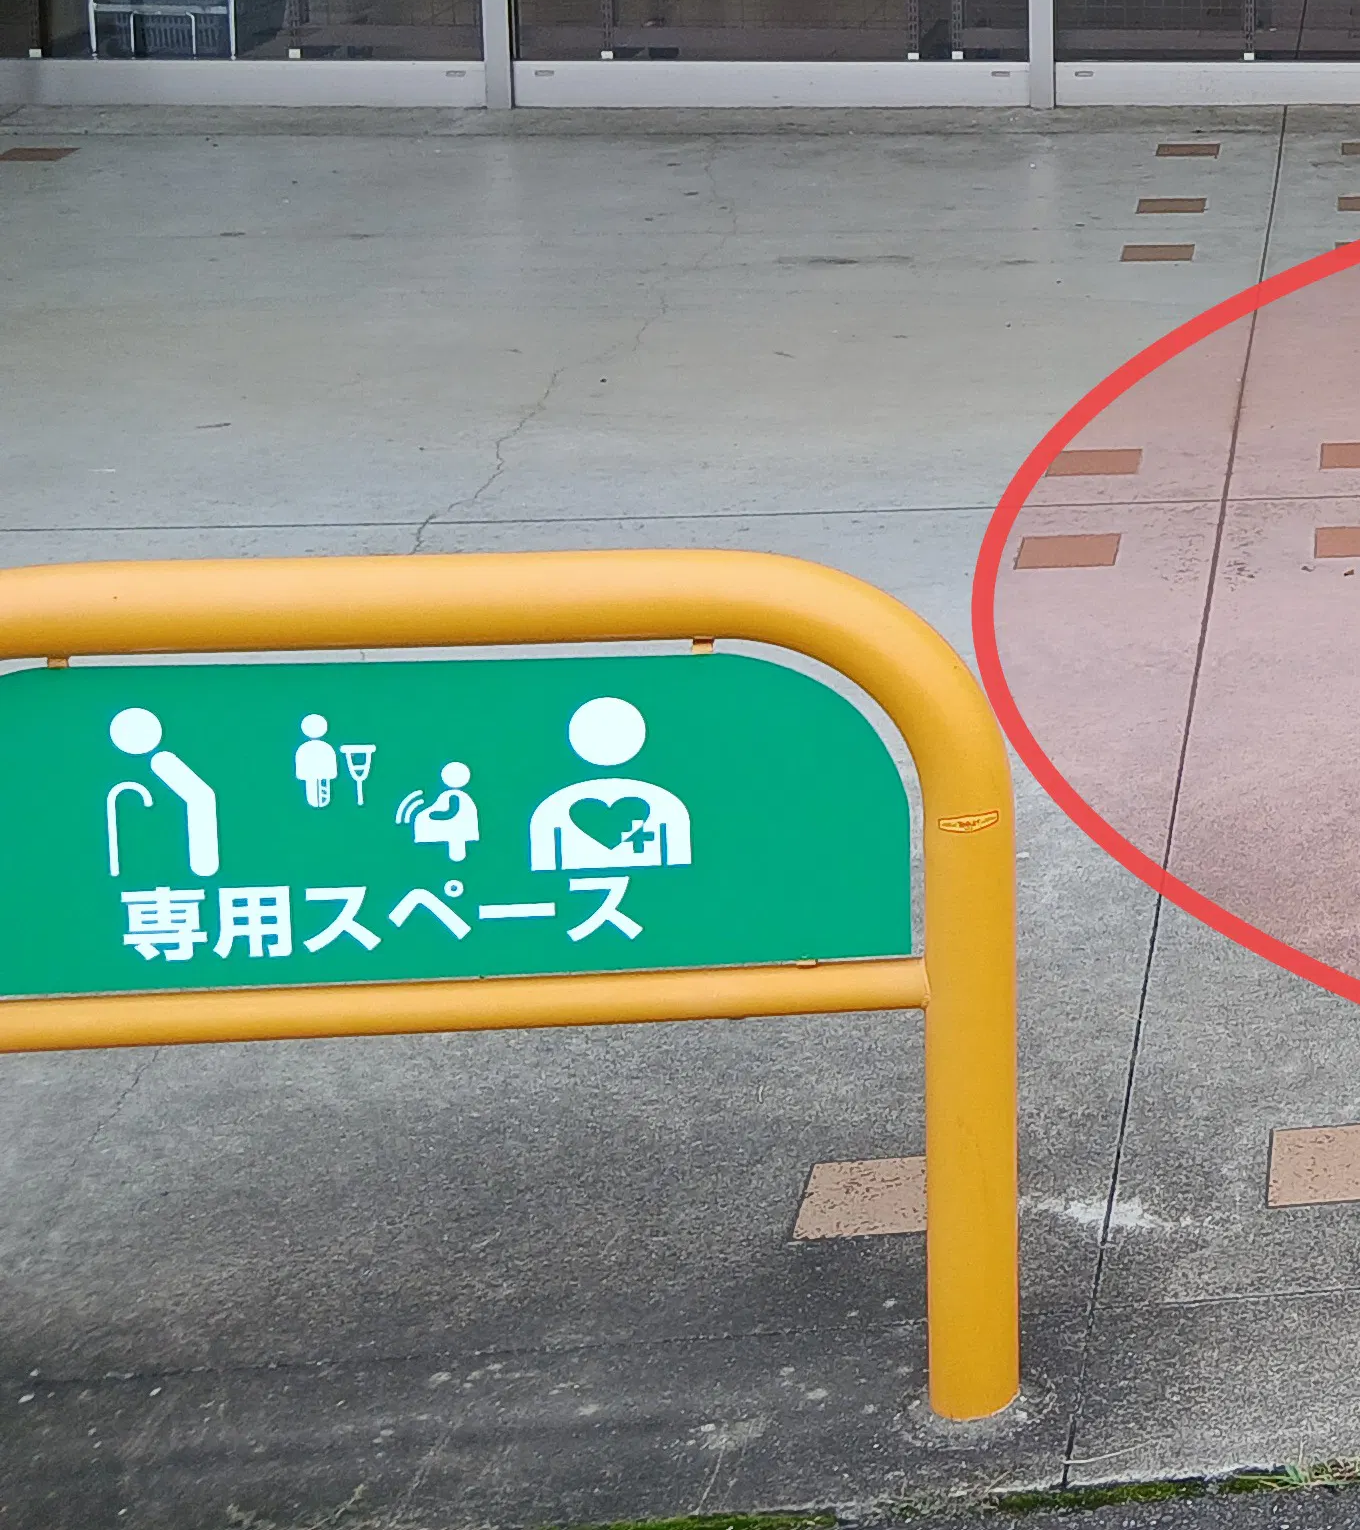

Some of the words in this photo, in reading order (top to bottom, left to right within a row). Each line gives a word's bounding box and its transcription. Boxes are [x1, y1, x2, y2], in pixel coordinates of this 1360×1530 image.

[121, 876, 644, 961] 専用スペース
